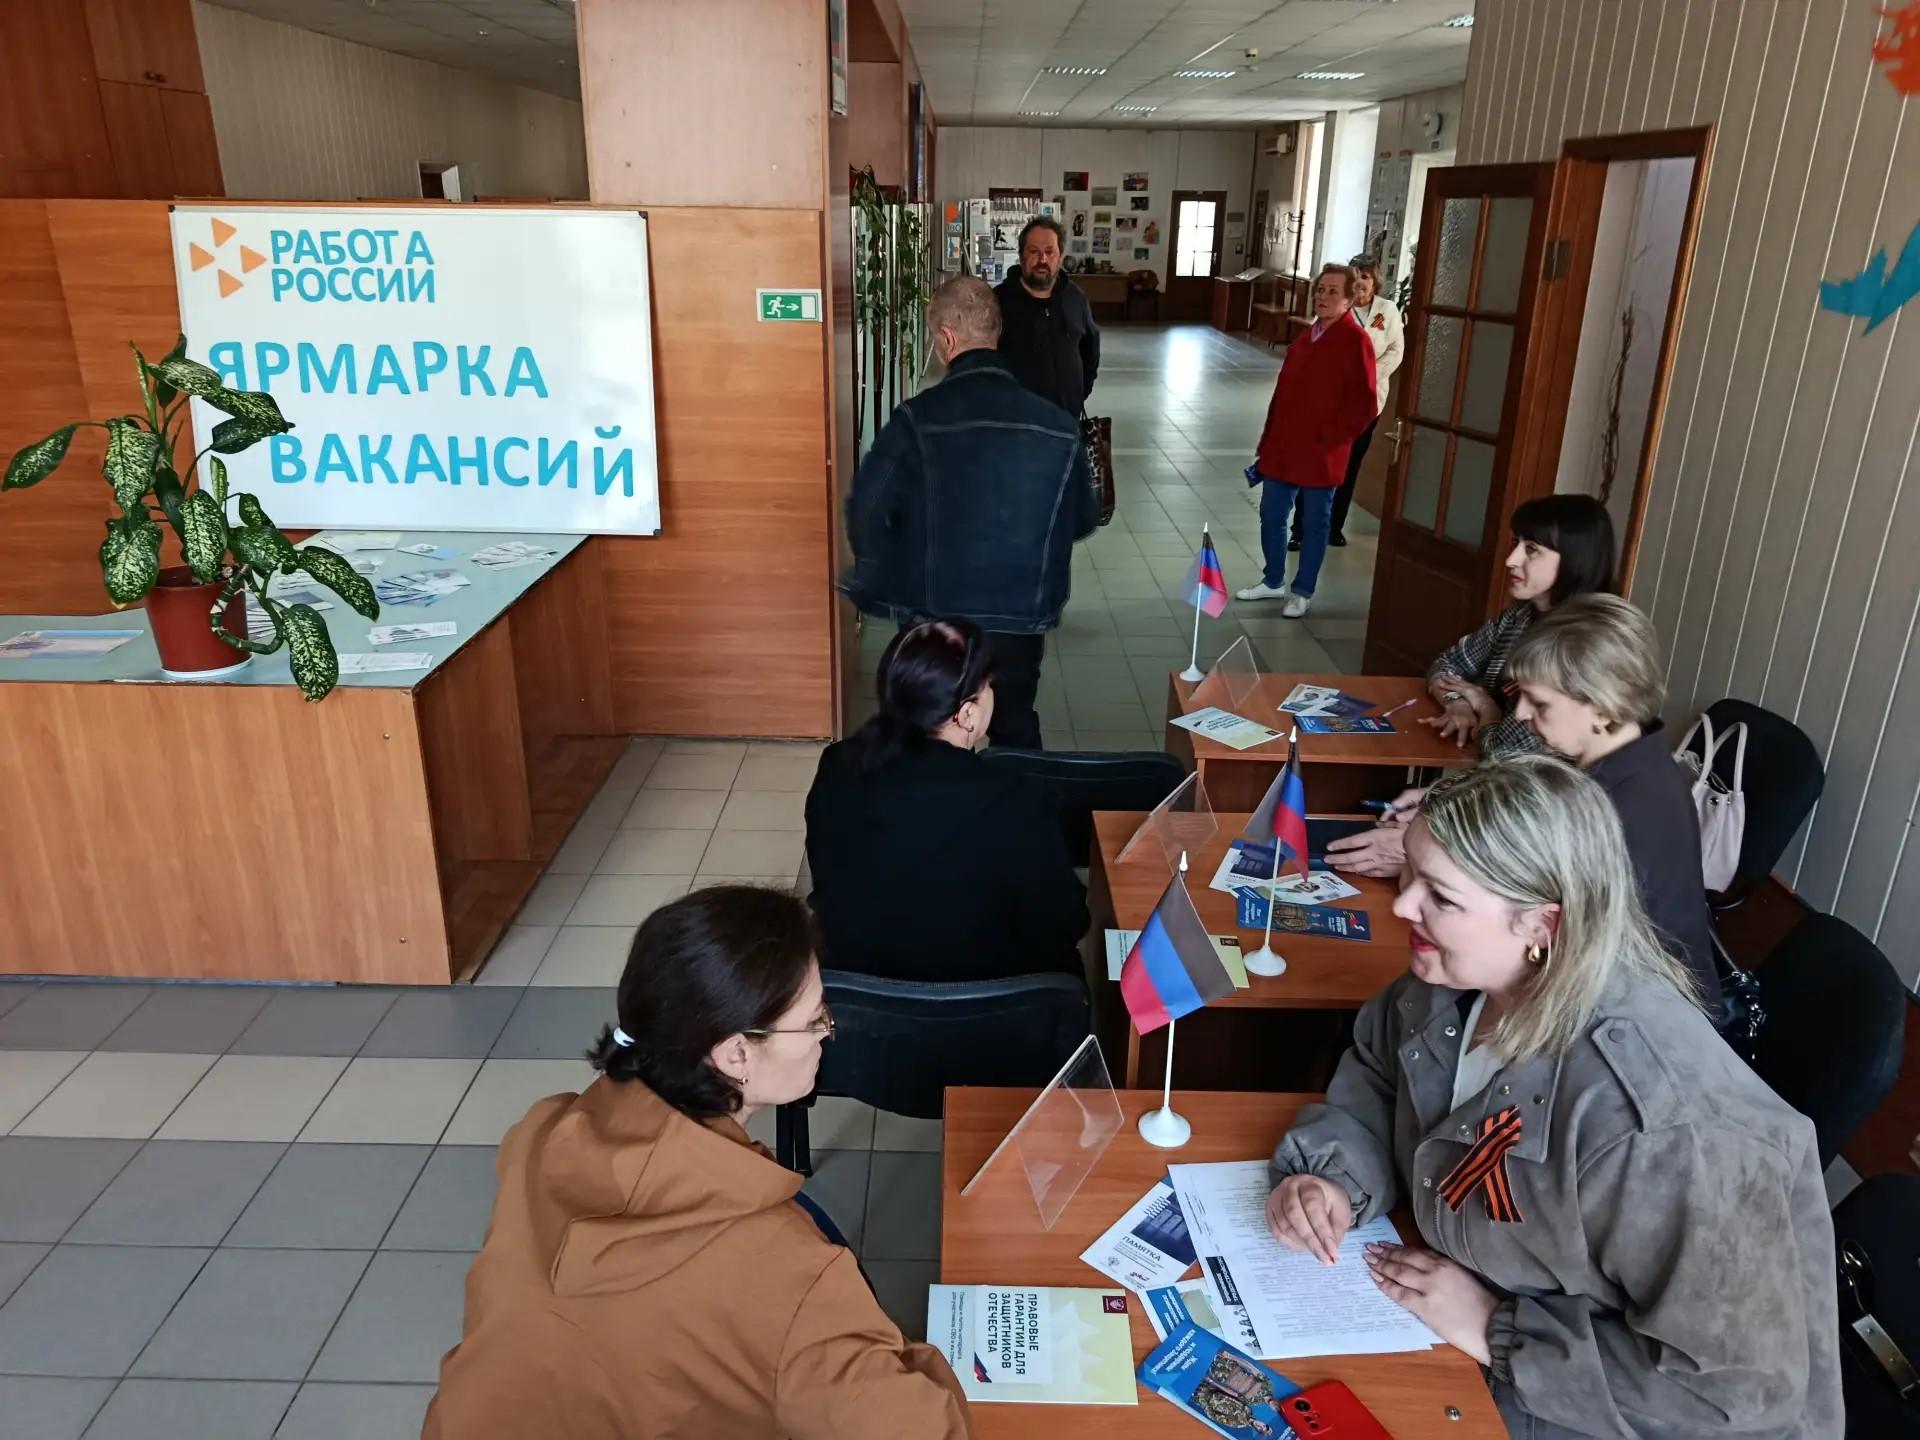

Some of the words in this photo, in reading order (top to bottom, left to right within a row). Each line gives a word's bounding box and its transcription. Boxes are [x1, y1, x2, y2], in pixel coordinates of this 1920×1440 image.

[270, 228, 434, 265] РАБОТА
[271, 267, 436, 303] РОССИИ
[208, 341, 549, 399] ЯРМАРКА
[270, 425, 635, 497] ВАКАНСИЙ
[1122, 1234, 1161, 1262] ПАМЯТКА
[988, 1292, 999, 1353] ОТЕЧЕСТВА
[1000, 1292, 1012, 1369] ЗАЩИТНИКОВ
[1015, 1293, 1026, 1347] ГАРАНТИИ
[1028, 1293, 1039, 1351] ПРАВОВЫЕ
[1014, 1350, 1026, 1375] ДЛЯ
